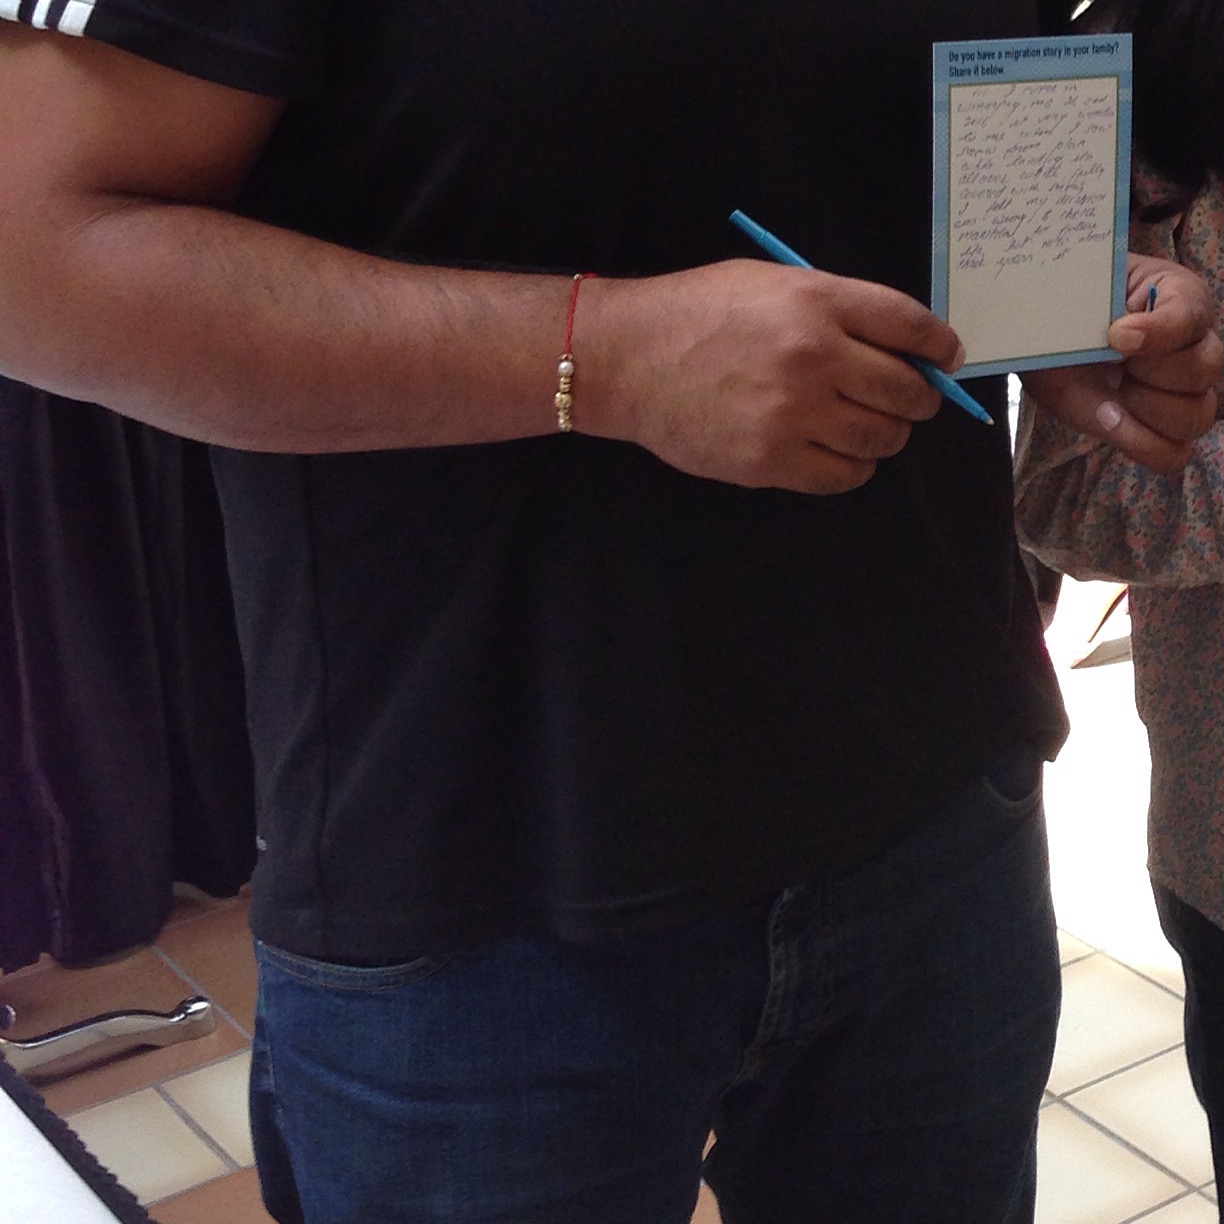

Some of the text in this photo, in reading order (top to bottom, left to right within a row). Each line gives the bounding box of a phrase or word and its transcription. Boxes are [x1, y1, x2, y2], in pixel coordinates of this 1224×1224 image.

[949, 42, 1119, 64] Do you have a migration story in your family?
[949, 66, 972, 77] Share
[973, 66, 979, 75] it
